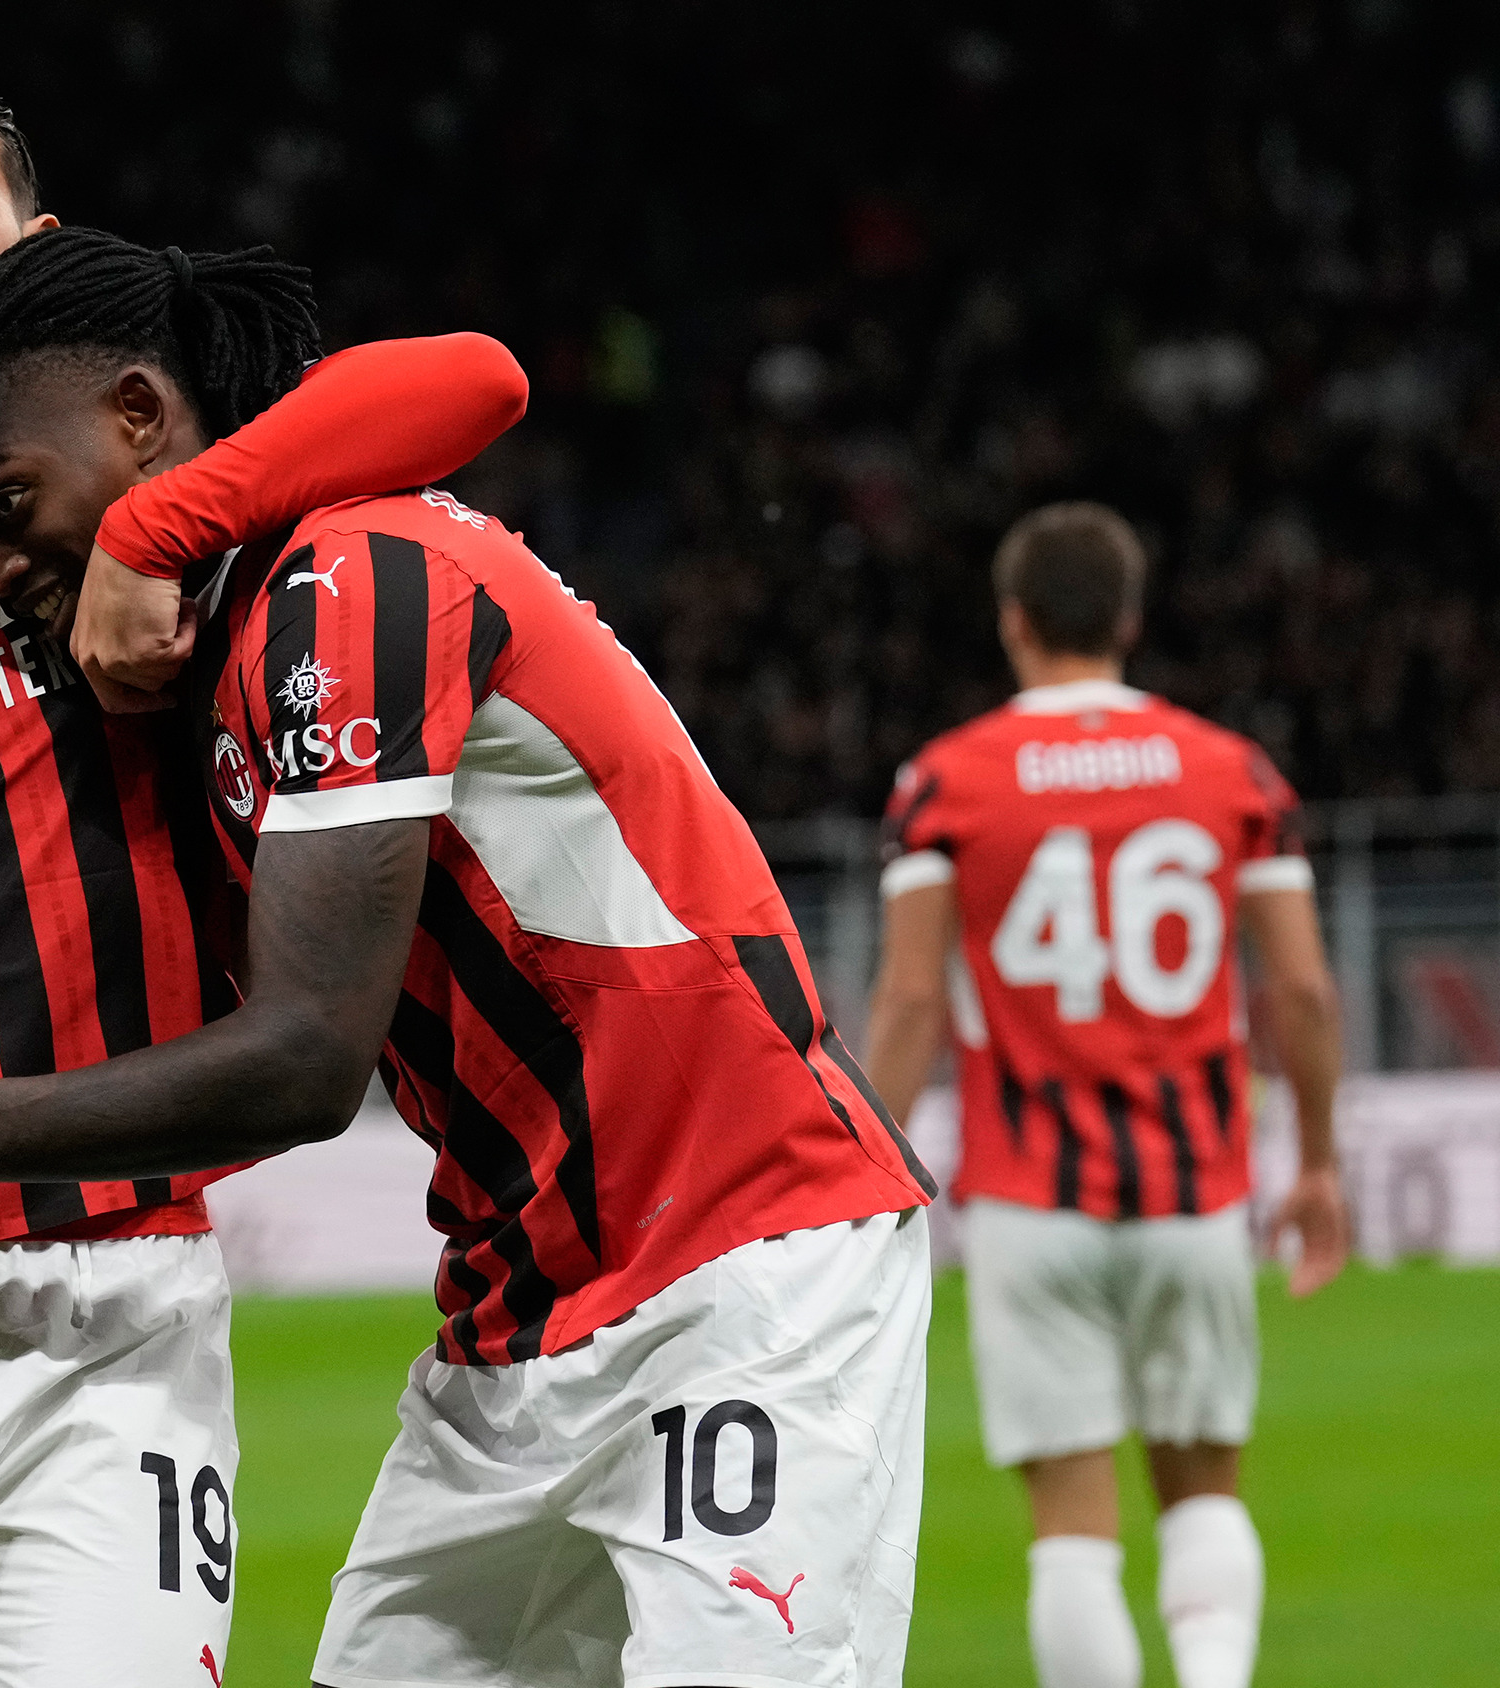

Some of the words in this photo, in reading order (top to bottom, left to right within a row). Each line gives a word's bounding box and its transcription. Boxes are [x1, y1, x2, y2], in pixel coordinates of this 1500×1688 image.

[235, 796, 253, 812] 1899
[263, 717, 381, 781] MSC
[990, 817, 1226, 1024] 46
[141, 1451, 232, 1604] 19
[651, 1399, 778, 1543] 10
